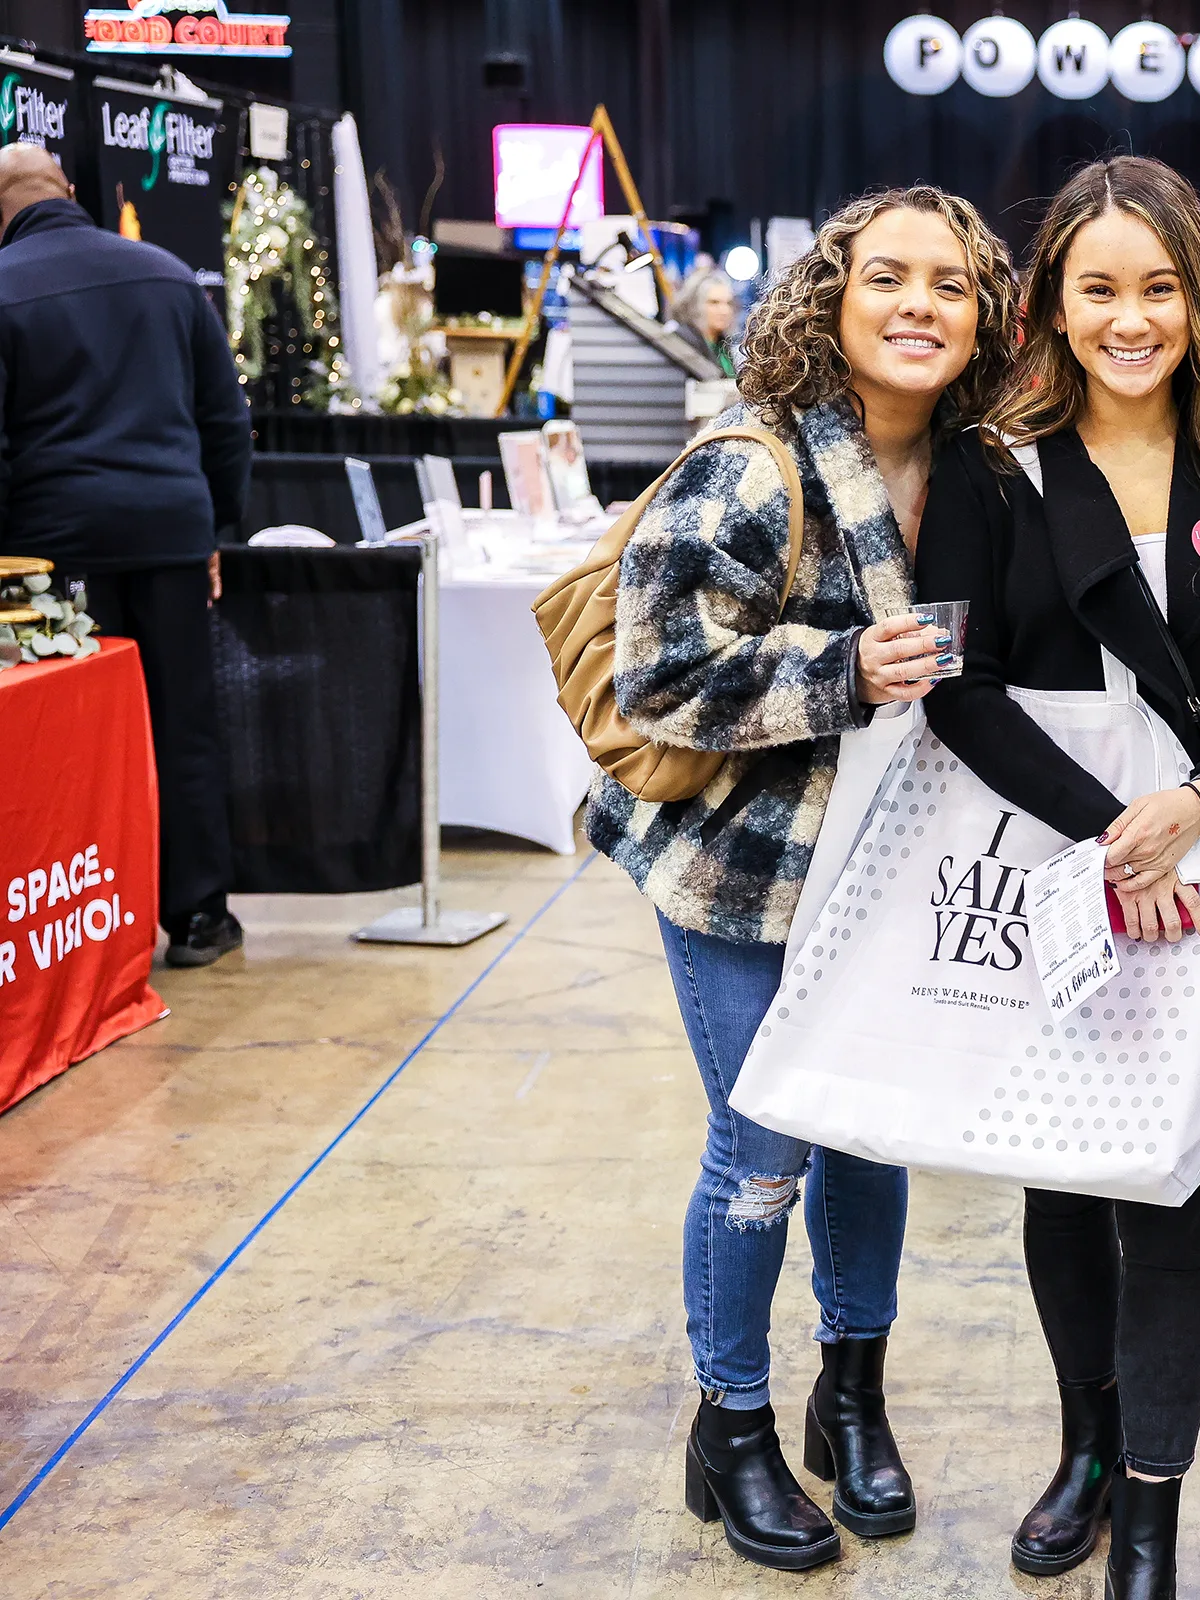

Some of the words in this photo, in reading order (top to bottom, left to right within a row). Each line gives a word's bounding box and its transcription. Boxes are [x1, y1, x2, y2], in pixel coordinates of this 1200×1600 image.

[15, 85, 65, 139] Filter
[102, 101, 150, 150] Leaf
[165, 112, 214, 159] Filter
[981, 809, 1017, 859] I
[7, 843, 115, 923] SPACE.
[929, 910, 1030, 971] YES
[911, 986, 939, 996] MEN'S
[1071, 960, 1100, 992] Doggy
[970, 1002, 990, 1011] Rentals
